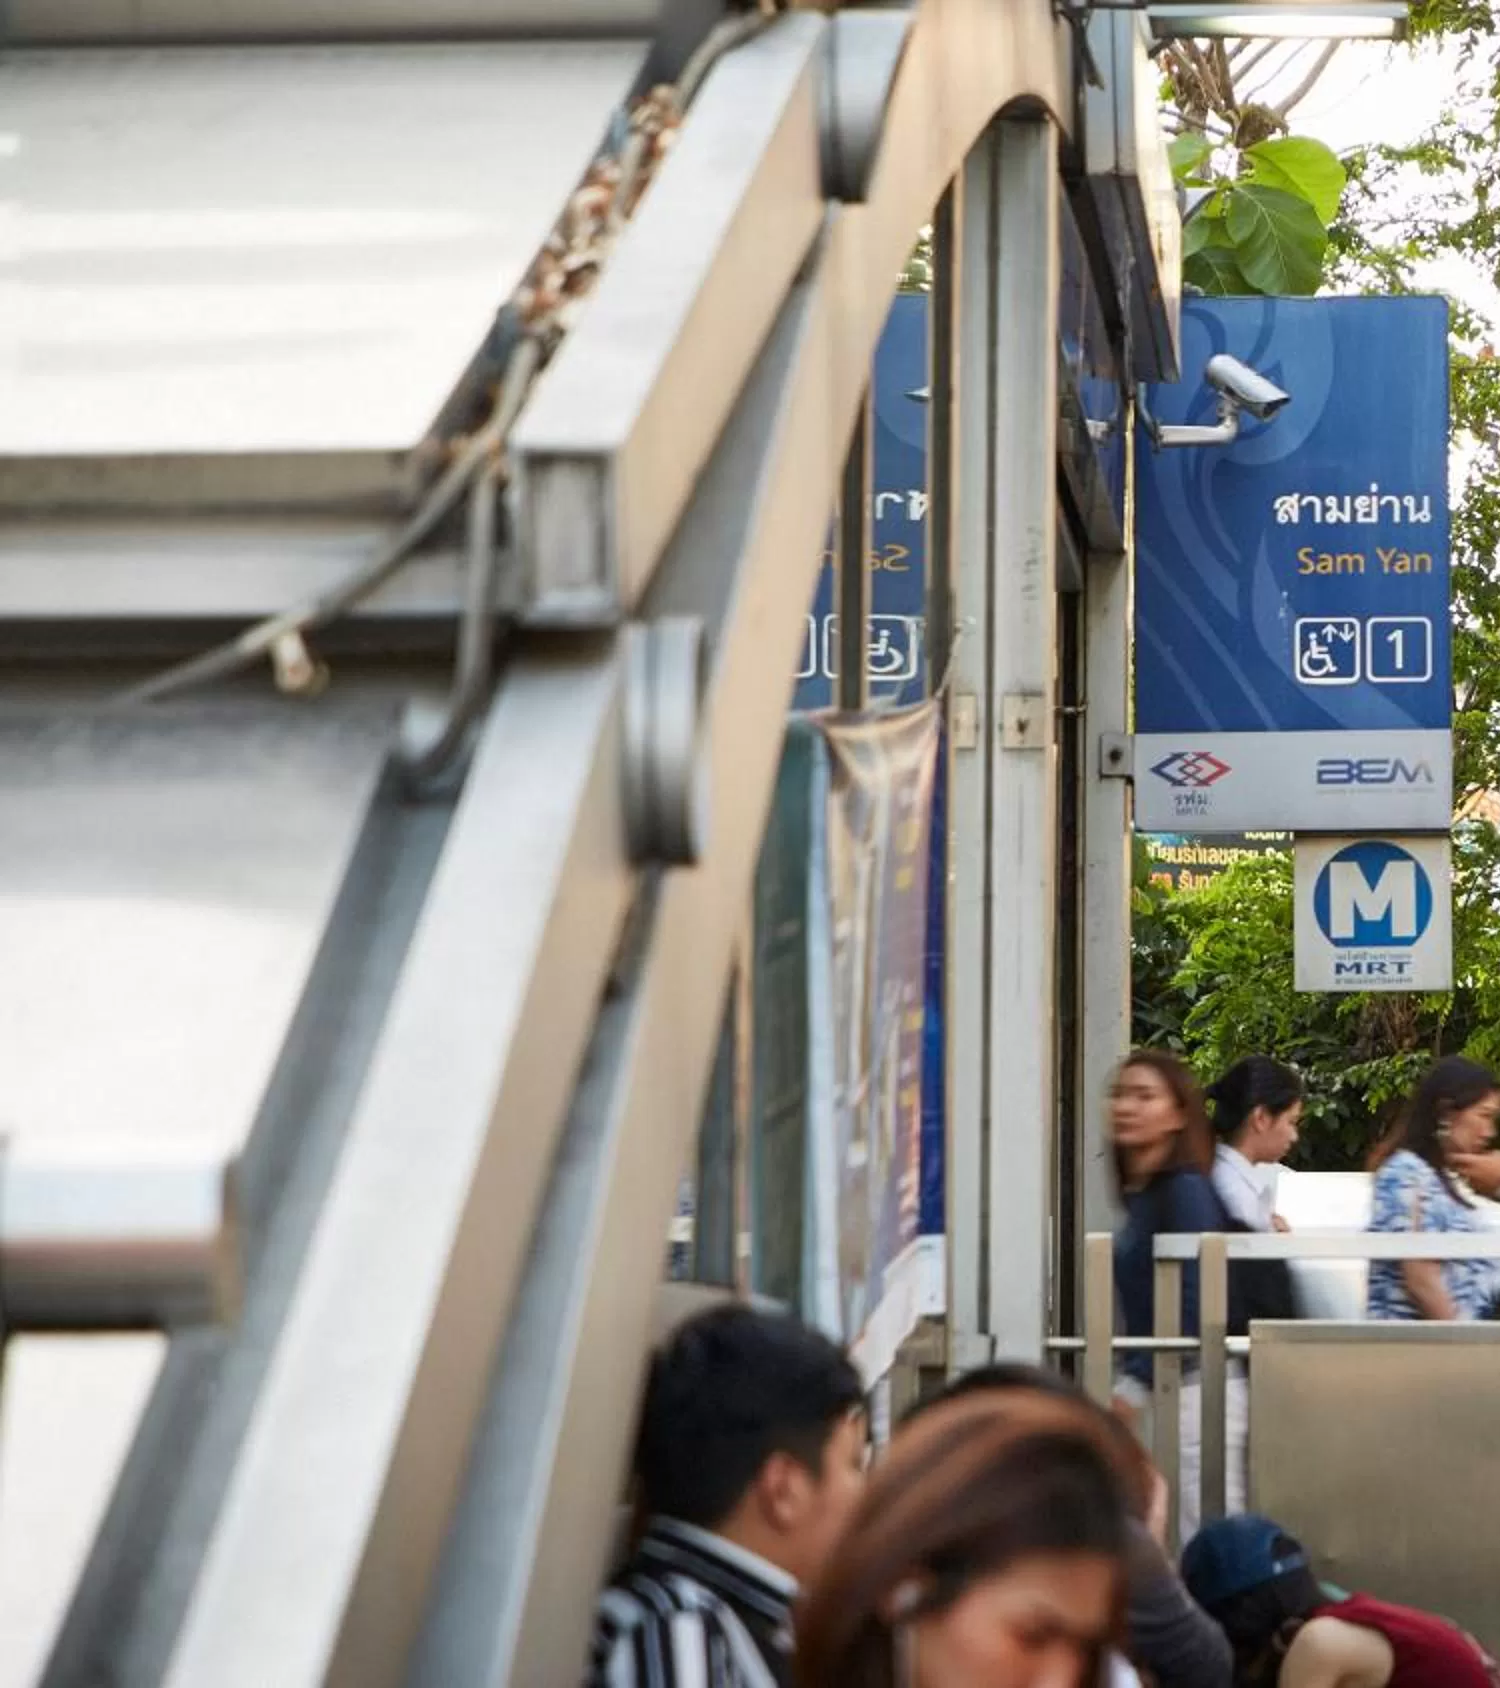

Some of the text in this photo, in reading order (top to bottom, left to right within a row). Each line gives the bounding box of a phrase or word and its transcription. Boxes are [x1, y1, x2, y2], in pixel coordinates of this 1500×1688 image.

[1274, 482, 1432, 524] สามย่าน
[1296, 546, 1433, 575] Sam Yan
[1386, 629, 1404, 670] 1
[1316, 758, 1435, 785] BEM
[1329, 860, 1417, 939] M
[1334, 961, 1412, 975] MRT
